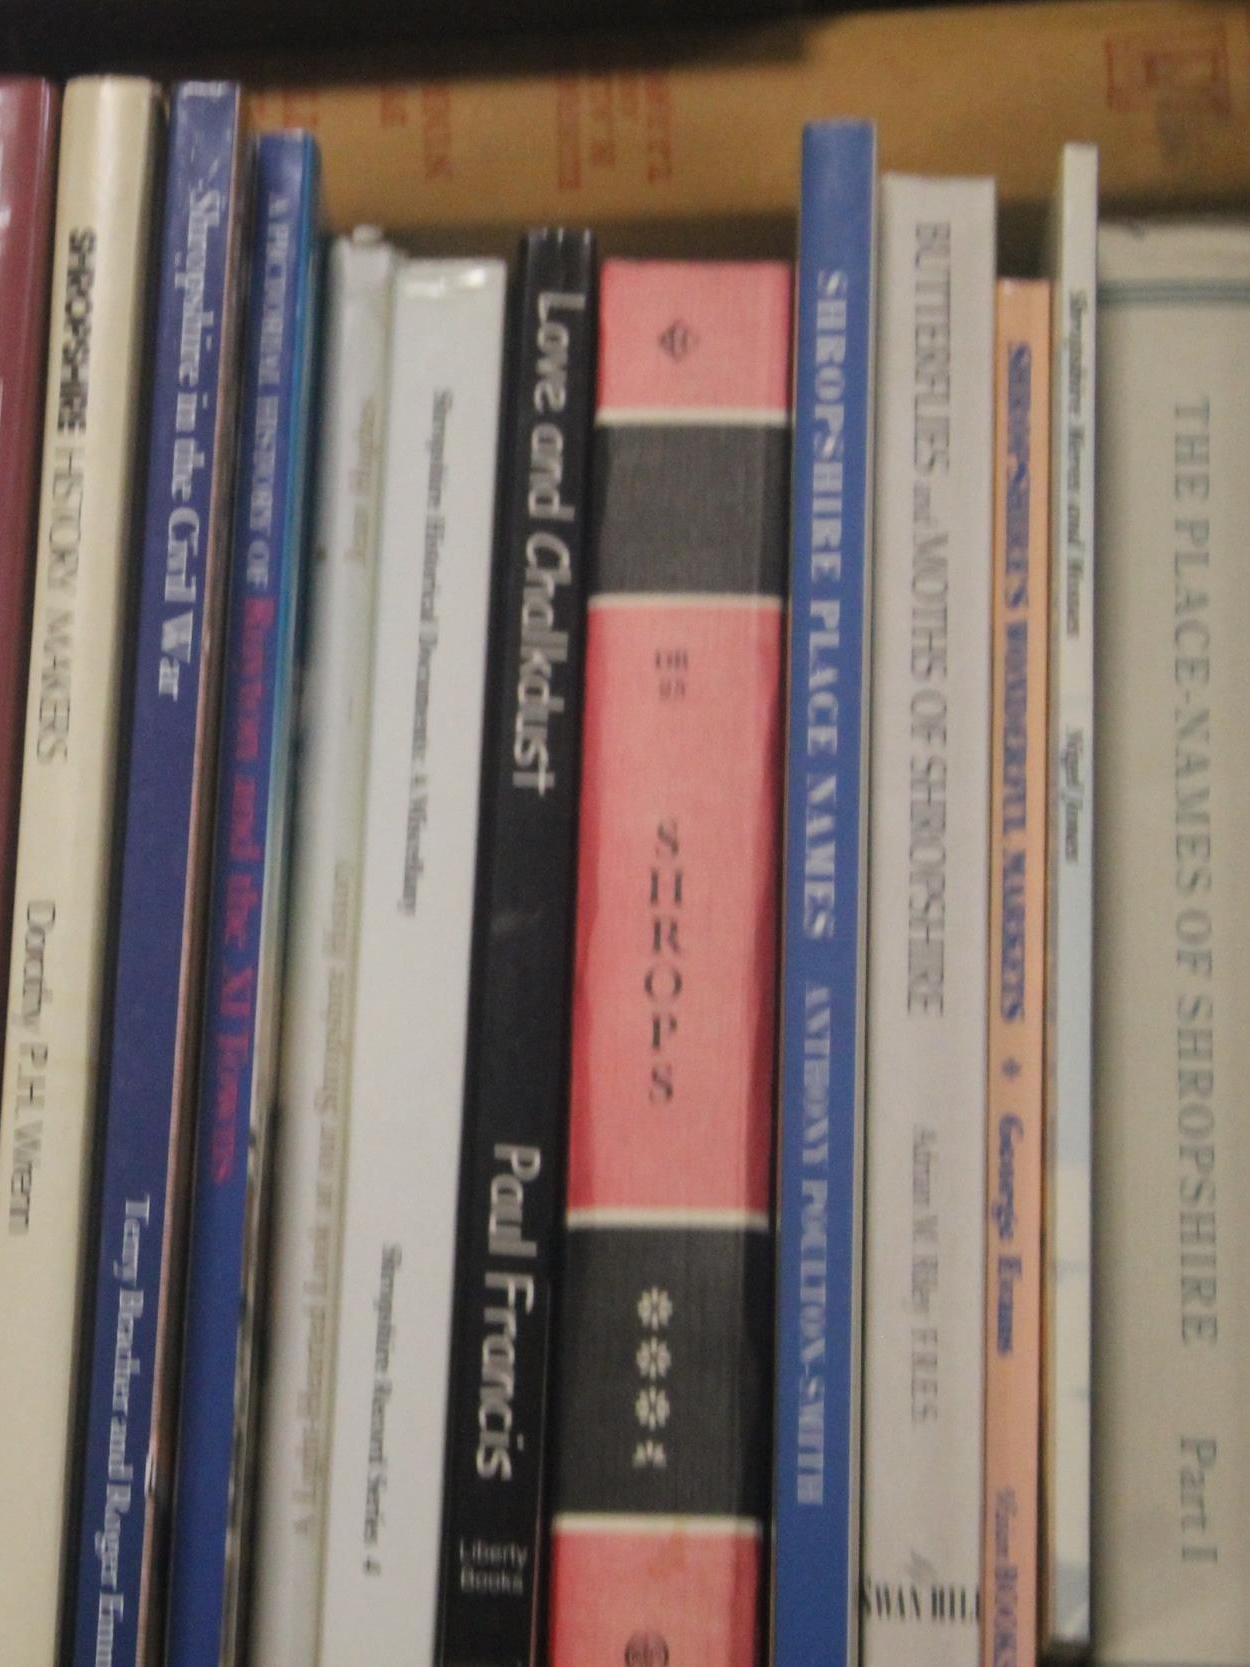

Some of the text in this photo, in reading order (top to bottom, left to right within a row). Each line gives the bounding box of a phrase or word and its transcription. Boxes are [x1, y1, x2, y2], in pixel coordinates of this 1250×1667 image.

[912, 221, 952, 476] BUTTERFLIES
[35, 230, 98, 766] SHROPSHIRE HISTORY MAKERS
[155, 188, 223, 703] Shropshire in the Civil War
[246, 393, 281, 538] HISTORY
[243, 538, 271, 594] OF
[510, 292, 586, 799] Love and Chalkdust
[802, 268, 846, 941] SHROPSHIRE PLACE NAMES
[910, 527, 949, 681] MOTHS
[909, 687, 947, 749] OF
[906, 755, 946, 1017] SHROPSHIRE
[1174, 395, 1217, 1351] THE PLACE-NAMES OF SHROPSHIRE
[10, 902, 57, 1034] Dorothy
[110, 1193, 151, 1287] Terry
[472, 1143, 543, 1483] Paul Francis
[796, 982, 832, 1508] ANTHONY POULTON-SMITH
[109, 1285, 146, 1417] Bracher
[105, 1415, 137, 1483] and
[1179, 1433, 1218, 1568] Part I
[91, 1481, 132, 1592] Roger
